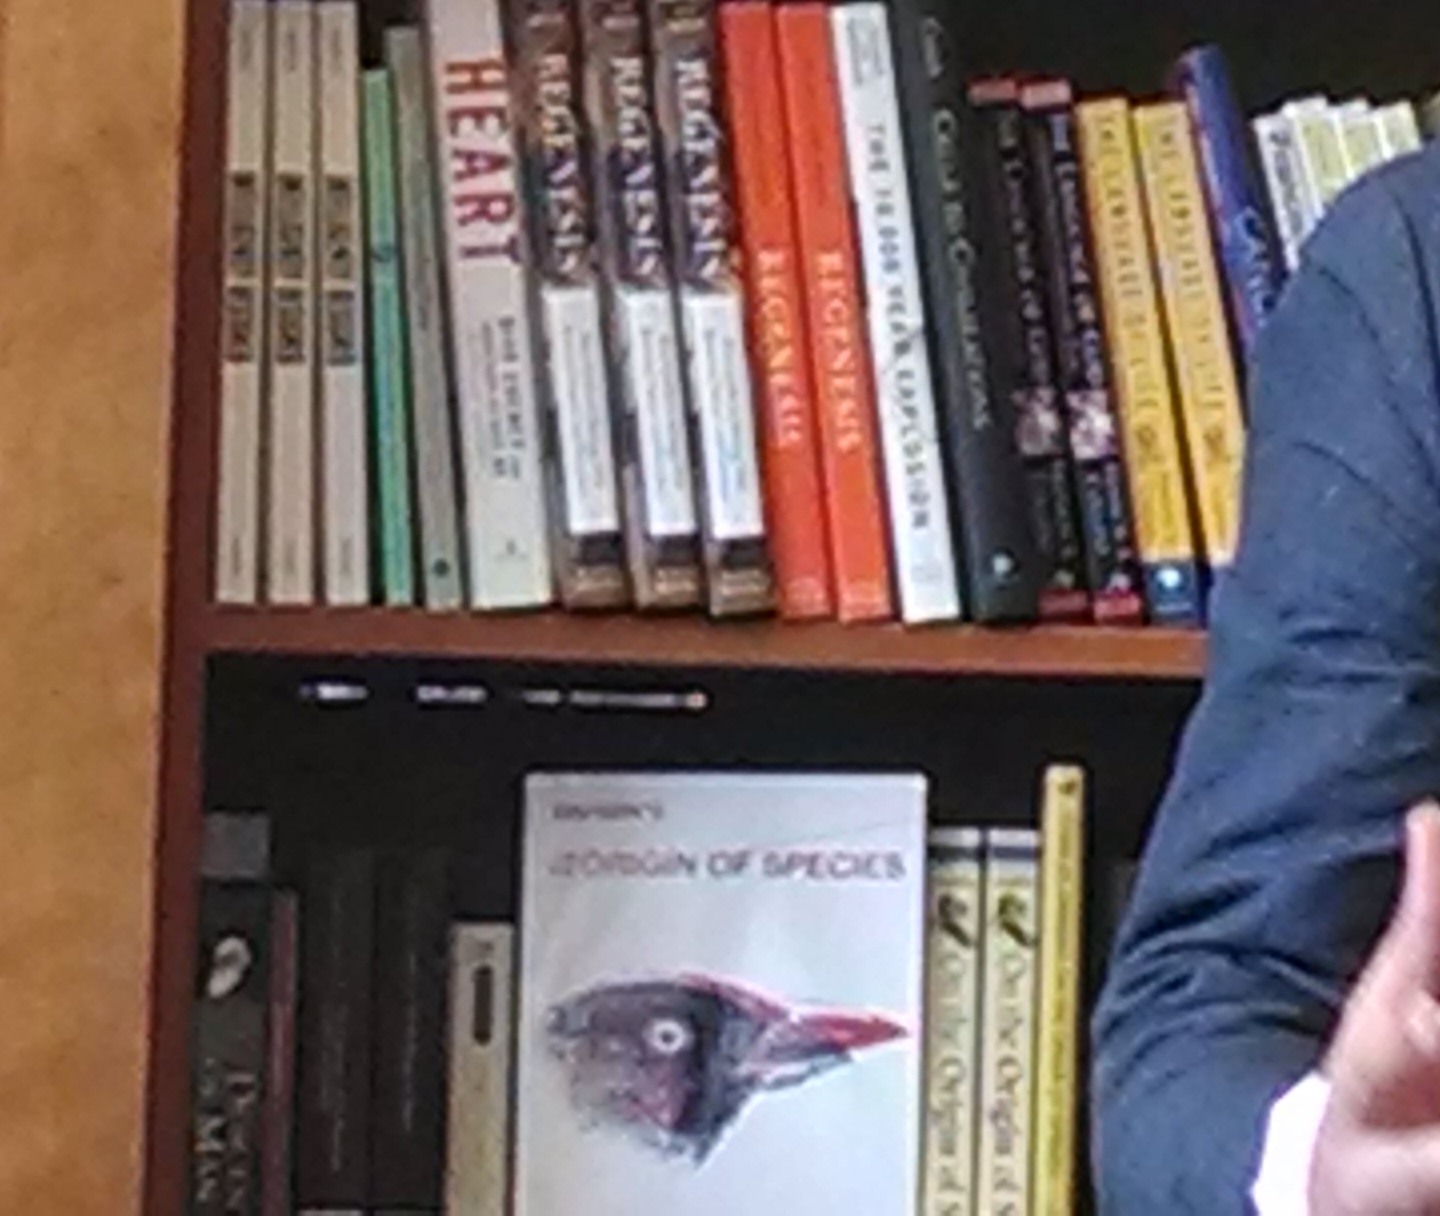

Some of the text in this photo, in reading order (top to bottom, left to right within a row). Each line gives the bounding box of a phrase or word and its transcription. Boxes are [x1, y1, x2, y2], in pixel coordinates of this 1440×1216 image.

[445, 53, 521, 268] HEART
[537, 51, 583, 274] REGENESIS
[609, 54, 657, 281] REGENESIS
[674, 56, 729, 283] REGENESIS
[756, 247, 802, 449] REGENESIS
[816, 249, 863, 455] REGENESIS
[706, 851, 750, 880] OF
[760, 851, 906, 882] SPECIES
